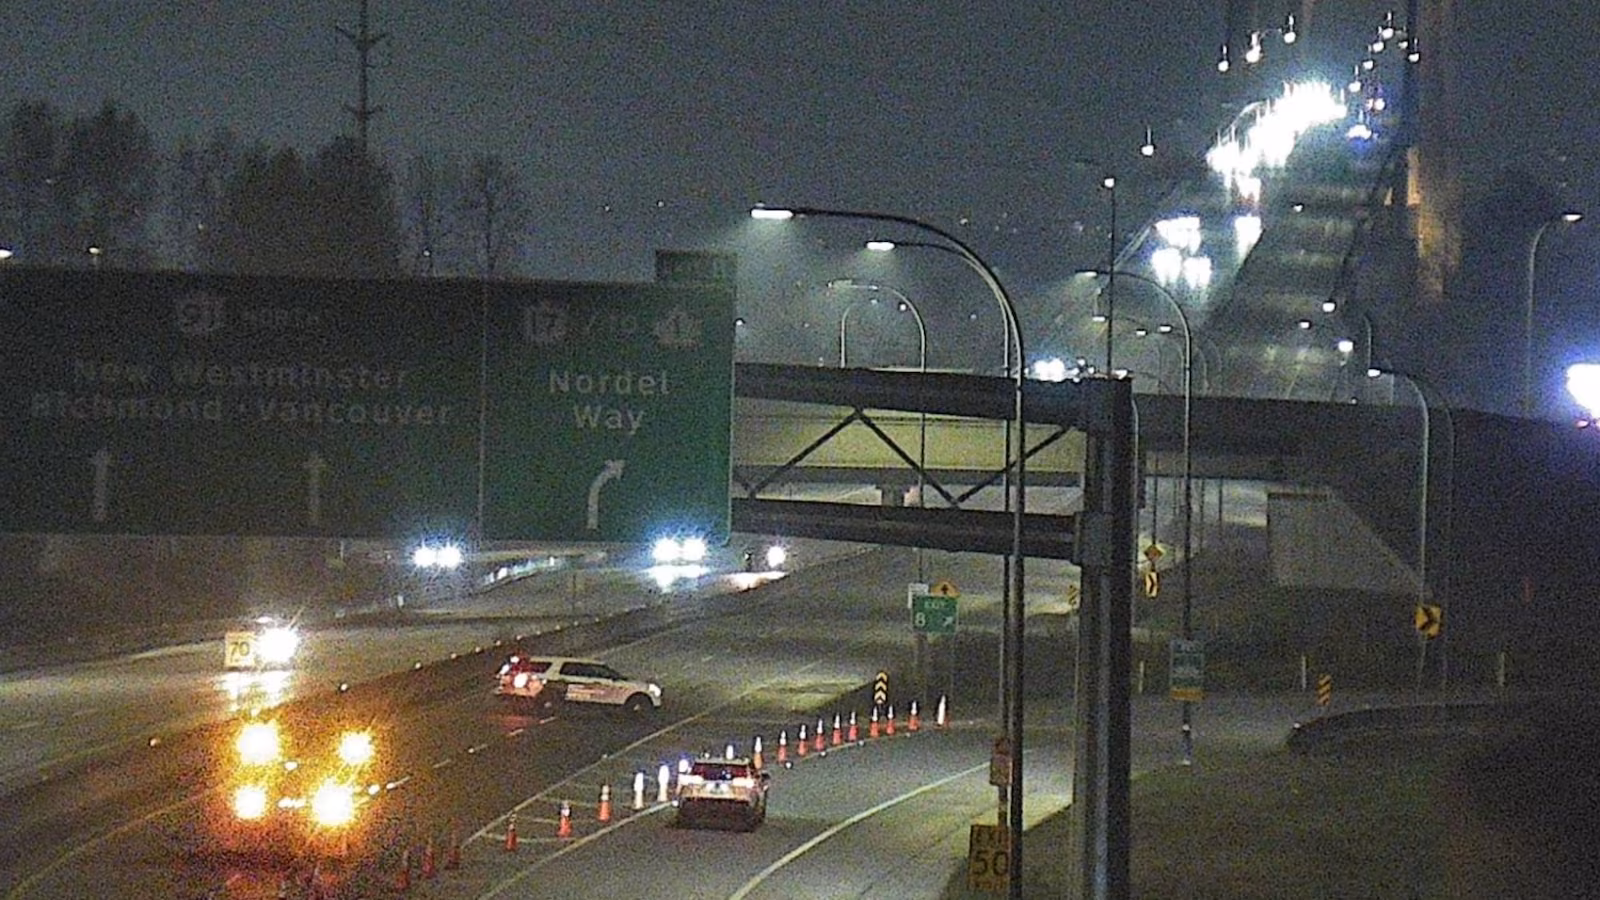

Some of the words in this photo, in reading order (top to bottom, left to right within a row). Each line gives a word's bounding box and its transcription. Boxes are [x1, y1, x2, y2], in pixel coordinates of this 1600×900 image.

[73, 359, 152, 383] New
[172, 358, 407, 390] Westminster
[549, 369, 671, 395] Nordel
[31, 389, 222, 421] Richmond
[257, 398, 452, 425] Vancouver
[574, 405, 645, 437] Way
[915, 612, 926, 627] 8
[230, 641, 250, 658] 70
[973, 850, 1009, 876] 50
